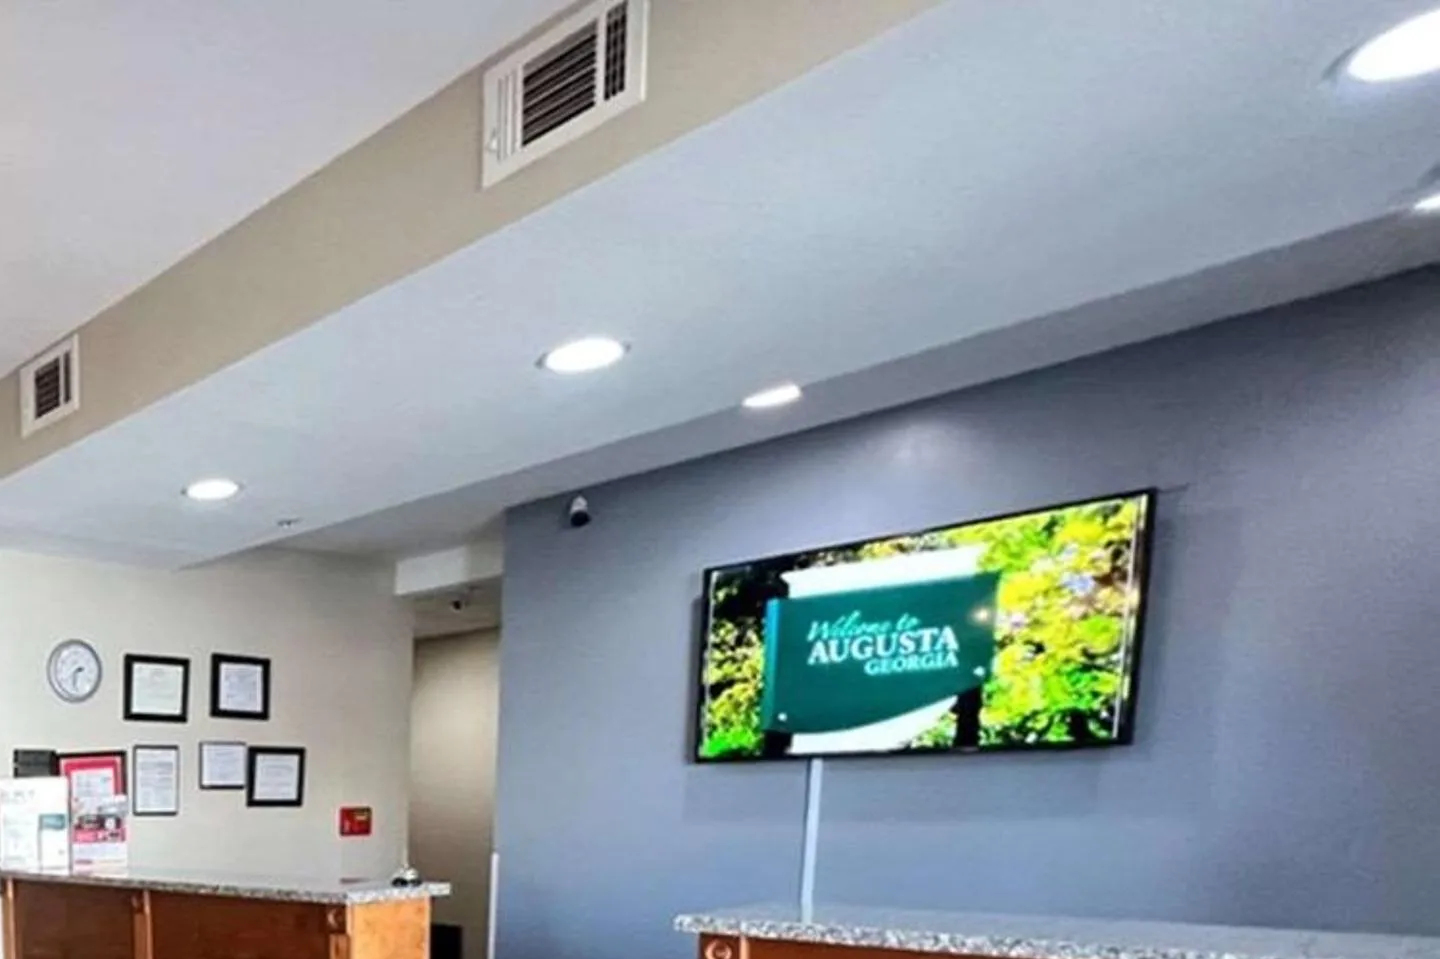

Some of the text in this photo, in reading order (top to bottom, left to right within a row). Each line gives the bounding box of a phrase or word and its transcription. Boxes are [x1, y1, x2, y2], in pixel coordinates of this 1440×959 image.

[896, 612, 920, 631] to
[807, 624, 959, 665] AUGUSTA
[864, 651, 959, 676] GEORGIA
